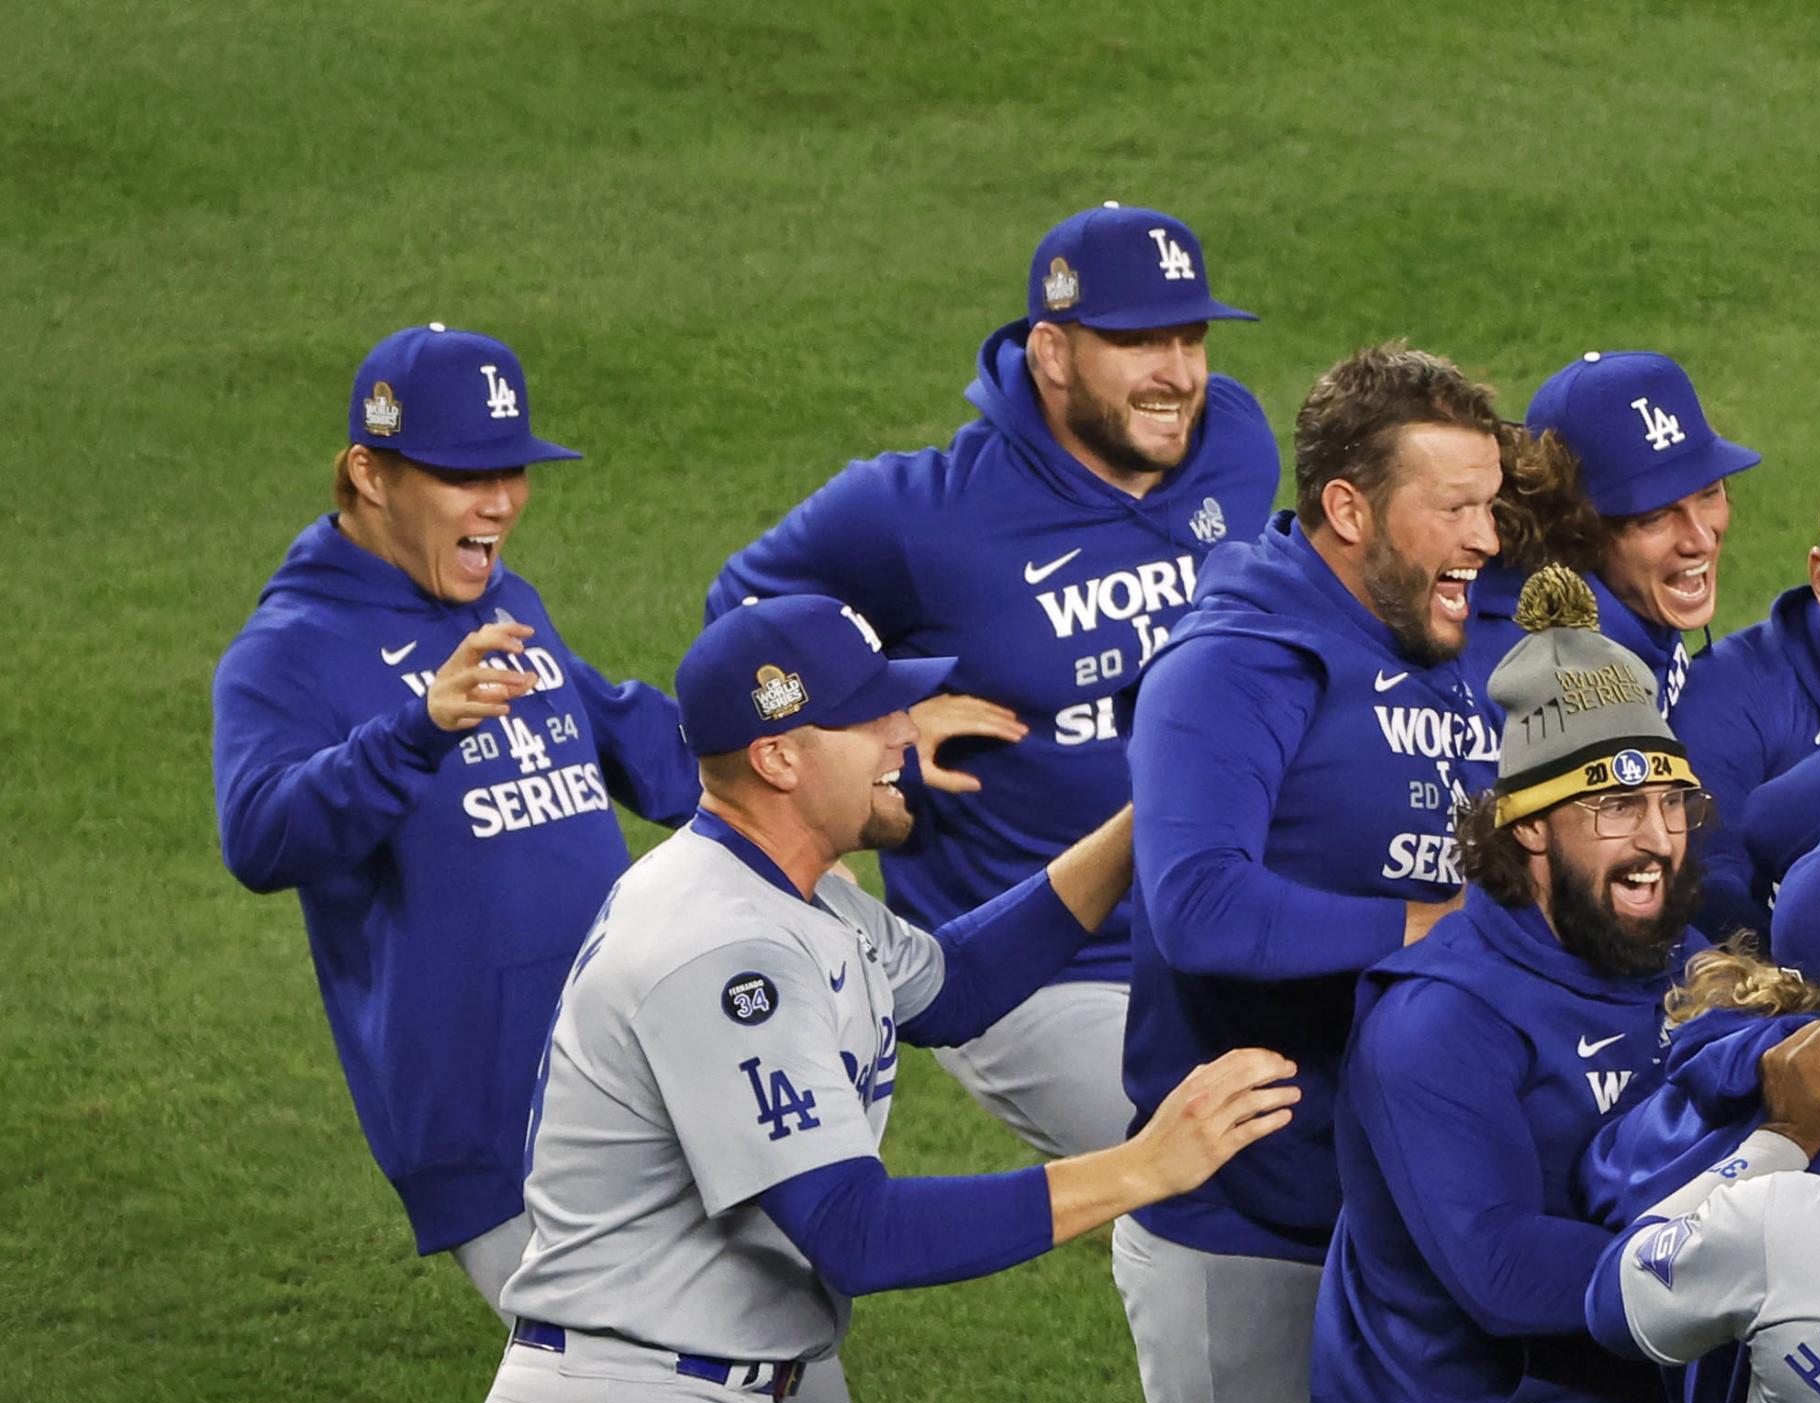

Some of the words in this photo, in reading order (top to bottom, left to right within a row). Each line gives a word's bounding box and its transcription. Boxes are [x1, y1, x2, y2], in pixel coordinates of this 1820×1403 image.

[1148, 229, 1195, 280] LA
[480, 365, 519, 418] LA
[1630, 397, 1686, 451] LA
[1036, 555, 1198, 638] WORL
[1075, 648, 1123, 686] 20
[756, 679, 800, 705] WORLD
[761, 689, 803, 715] SERIES
[1562, 684, 1647, 716] SERIES
[459, 731, 499, 764] 20
[546, 713, 579, 744] 24
[1585, 762, 1608, 786] 20
[1620, 755, 1642, 781] LA
[1652, 756, 1672, 776] 24
[463, 762, 609, 838] SERIES
[728, 979, 765, 997] FERNANDO
[733, 988, 770, 1018] 34
[738, 1056, 822, 1142] LA
